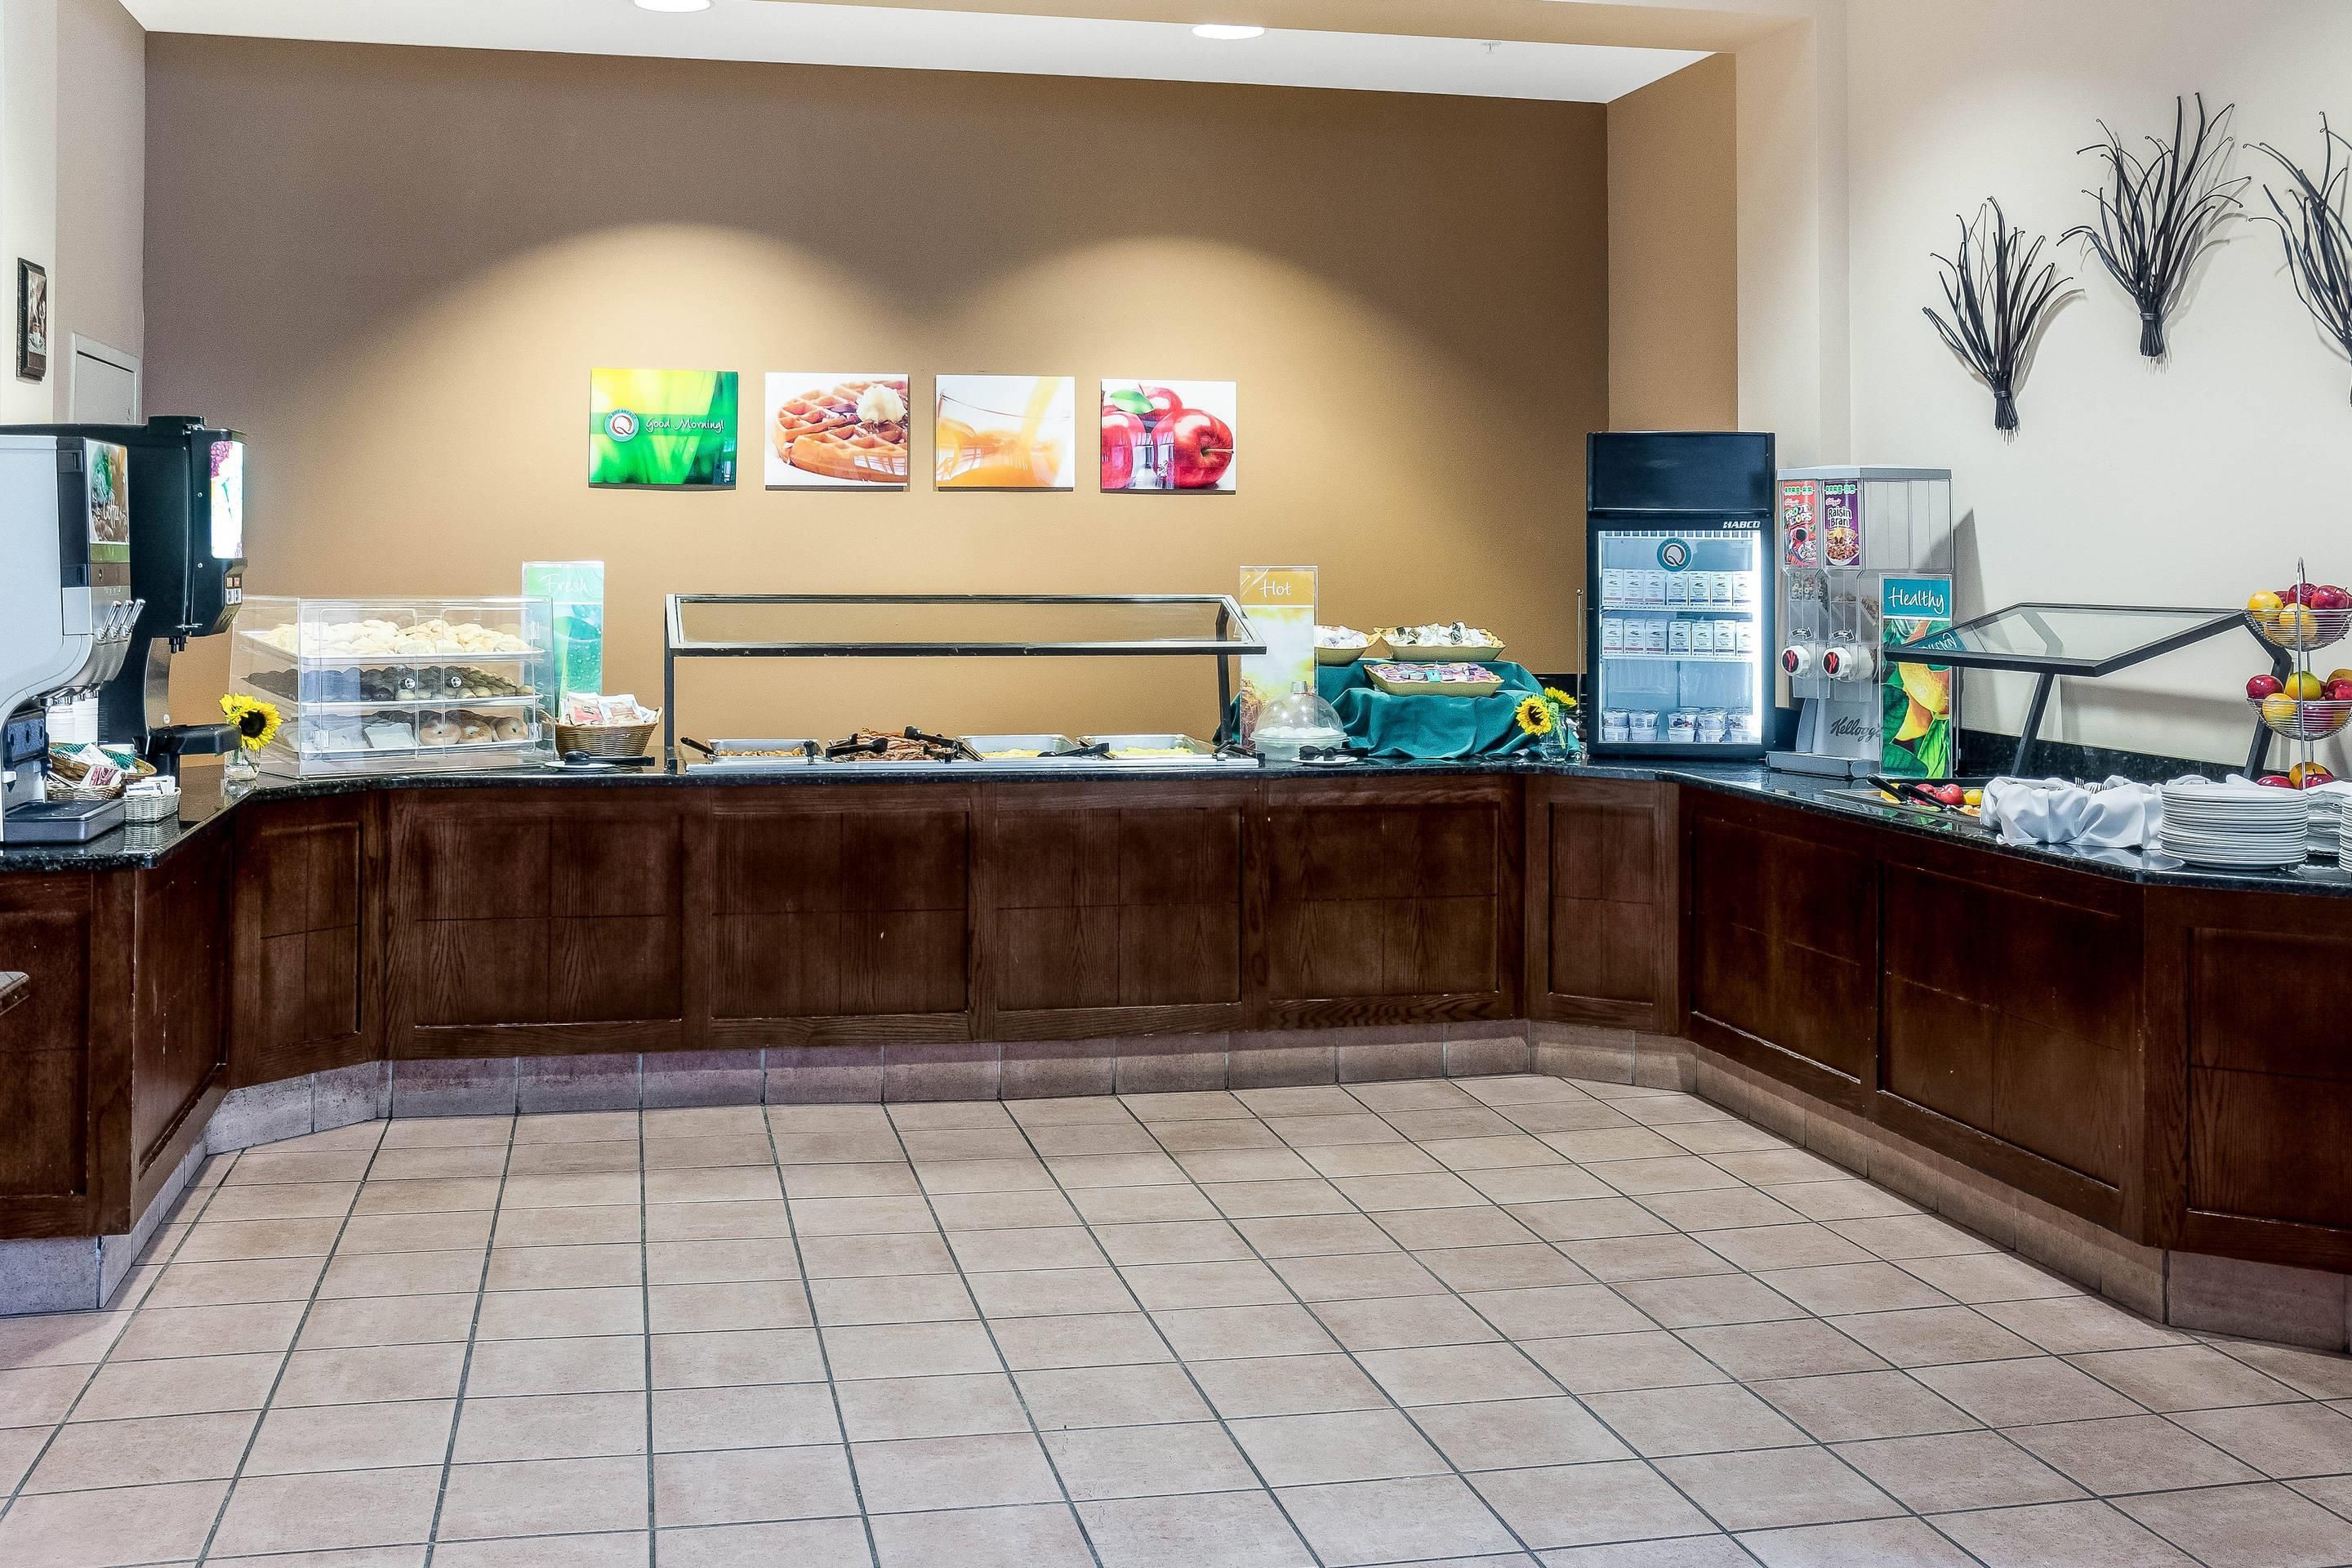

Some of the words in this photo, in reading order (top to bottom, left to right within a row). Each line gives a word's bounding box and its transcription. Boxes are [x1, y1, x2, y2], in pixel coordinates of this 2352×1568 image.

[645, 416, 670, 433] Good
[673, 417, 724, 433] Morning!
[1828, 506, 1852, 519] Raisin
[1722, 520, 1761, 529] HABCO
[1829, 517, 1850, 528] Bran
[538, 573, 588, 595] Fresh
[1258, 578, 1292, 598] Hot
[1888, 586, 1945, 615] Healthy
